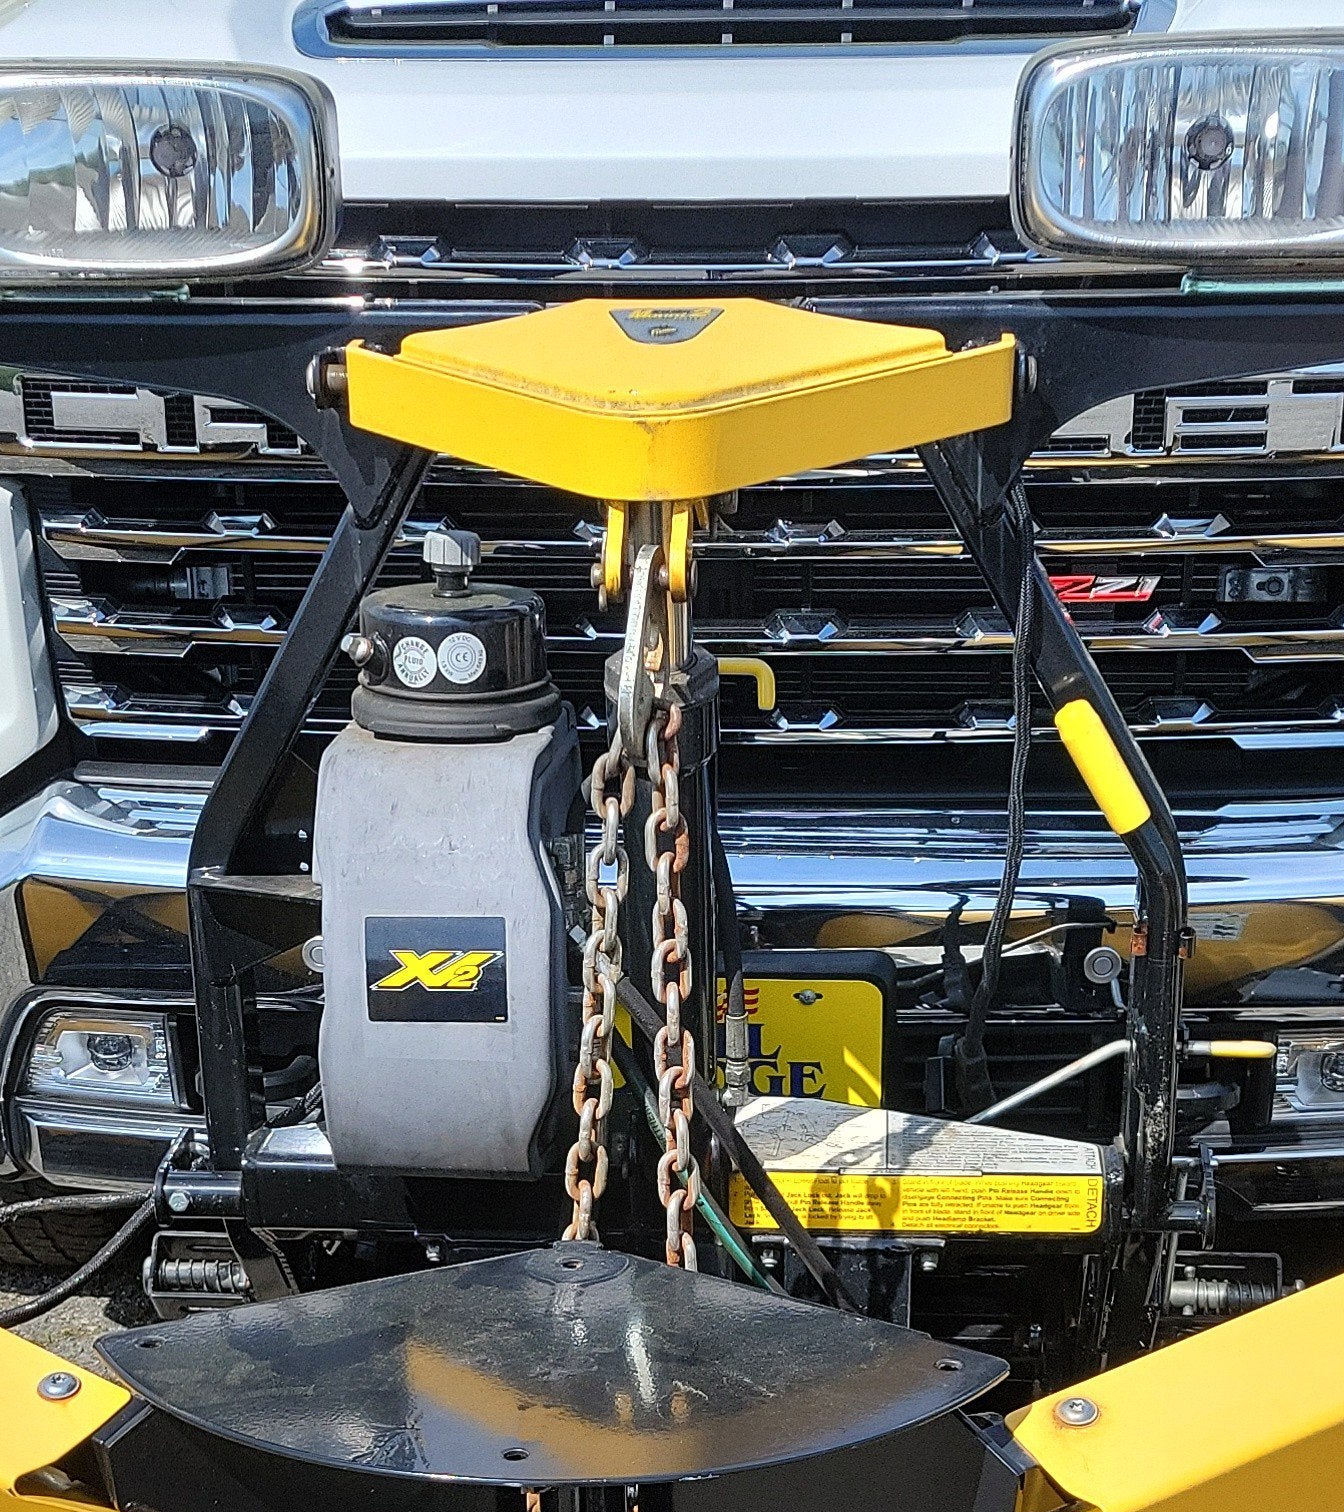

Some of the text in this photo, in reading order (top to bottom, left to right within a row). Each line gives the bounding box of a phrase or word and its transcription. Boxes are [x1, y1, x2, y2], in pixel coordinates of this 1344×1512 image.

[401, 640, 429, 654] CHANGE
[404, 655, 423, 665] FLUID
[398, 663, 429, 682] ANNUALLY
[369, 949, 505, 992] XV2
[1086, 1178, 1099, 1228] DETACH
